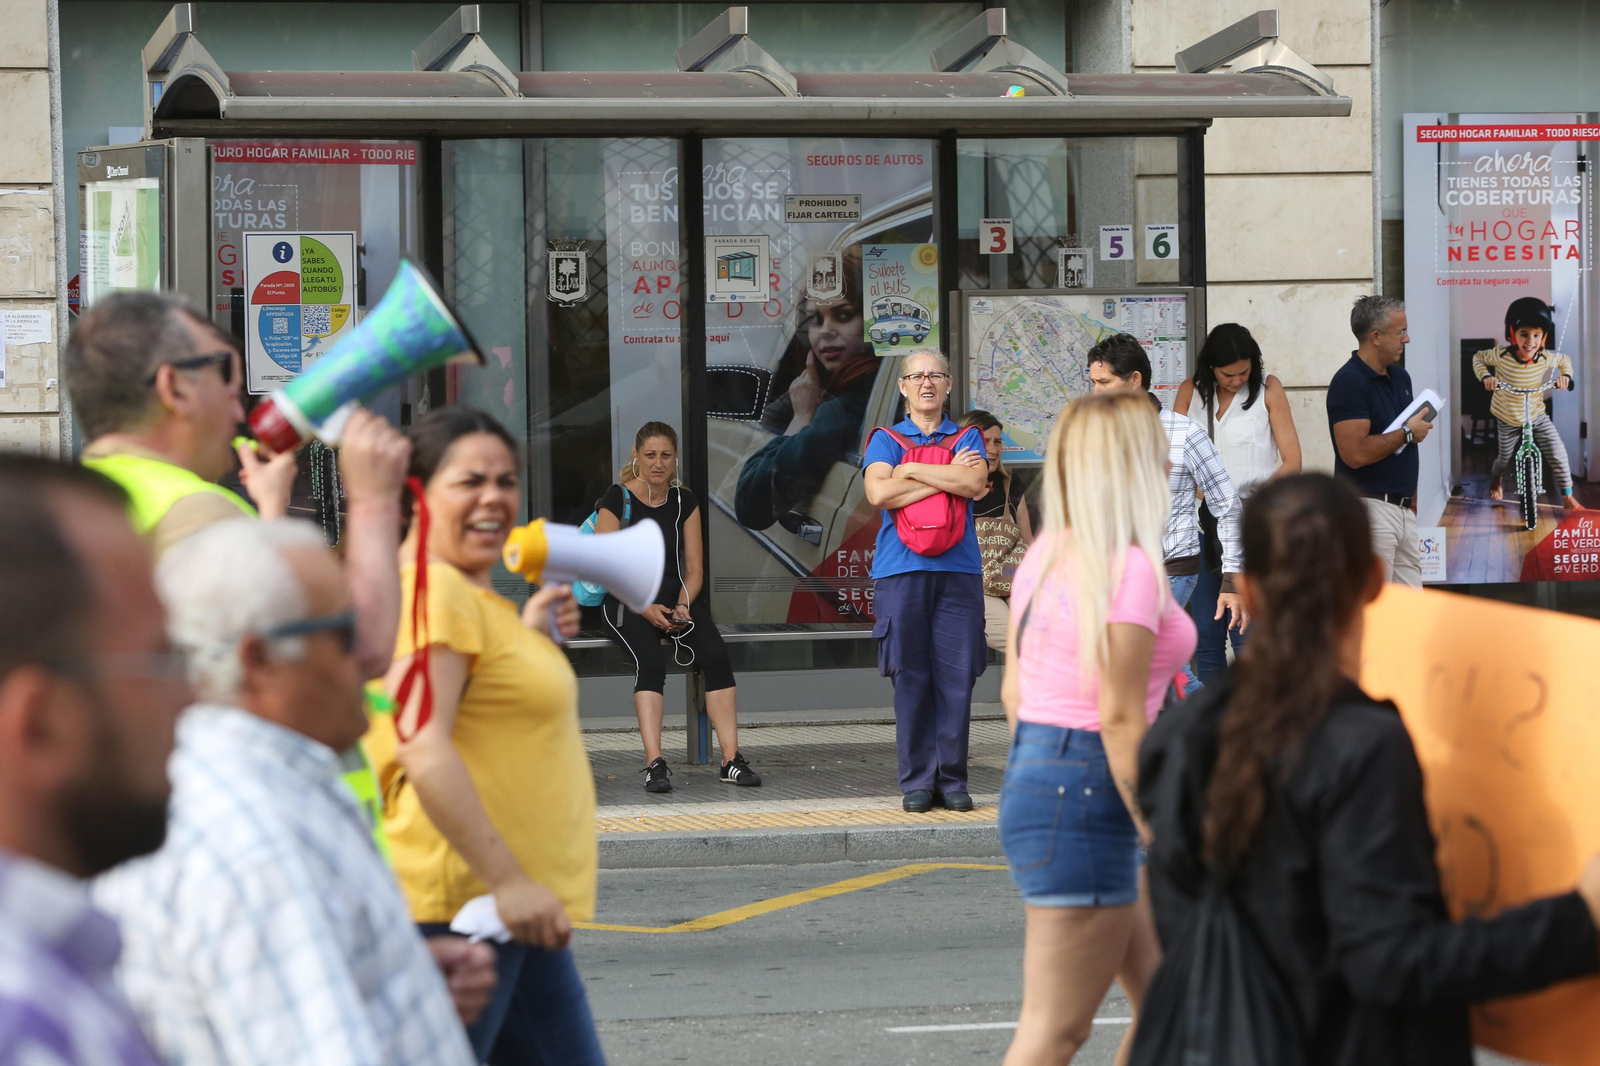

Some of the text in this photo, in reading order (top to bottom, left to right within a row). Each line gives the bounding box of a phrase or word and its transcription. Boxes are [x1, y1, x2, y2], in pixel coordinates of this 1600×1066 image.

[1420, 129, 1457, 139] SEGURO
[1459, 129, 1491, 138] HOGAR
[1493, 128, 1538, 138] FAMILIAR
[1545, 128, 1570, 137] TODO
[1572, 127, 1600, 137] RIESG
[215, 147, 243, 158] URO
[246, 147, 289, 158] HOGAR
[292, 148, 350, 159] FAMILIAR
[360, 149, 393, 160] TODO
[395, 149, 415, 160] RIE
[807, 154, 924, 166] SEGUROS DE AUTOS
[1474, 149, 1552, 175] ahora
[1447, 175, 1581, 188] TIENES TODAS LAS
[630, 184, 674, 201] TUS
[752, 181, 779, 199] SE
[1445, 189, 1581, 206] COBERTURAS
[257, 199, 287, 211] LAS
[799, 199, 848, 207] PROHIBIDO
[787, 211, 860, 219] FIJAR CARTELES
[1502, 207, 1527, 218] QUE
[215, 212, 287, 229] TURAS
[1446, 219, 1581, 241] tu HOGAR
[989, 226, 1007, 253] 3
[1152, 232, 1171, 259] 6
[1109, 235, 1124, 259] 5
[1447, 245, 1581, 262] NECESITA
[868, 261, 906, 280] Súbete
[870, 277, 911, 297] al BUS
[1436, 277, 1471, 286] Contrata
[1483, 278, 1510, 287] seguro
[1512, 276, 1529, 287] aquí
[302, 284, 337, 293] AUTOBÚS
[623, 335, 663, 344] Contrata
[665, 335, 675, 343] tu
[710, 333, 730, 344] aquí
[1554, 528, 1599, 538] FAMILI
[1554, 538, 1600, 549] DE VERD
[1554, 553, 1599, 564] SEGUR
[837, 565, 859, 578] DE
[1563, 563, 1599, 573] VERD
